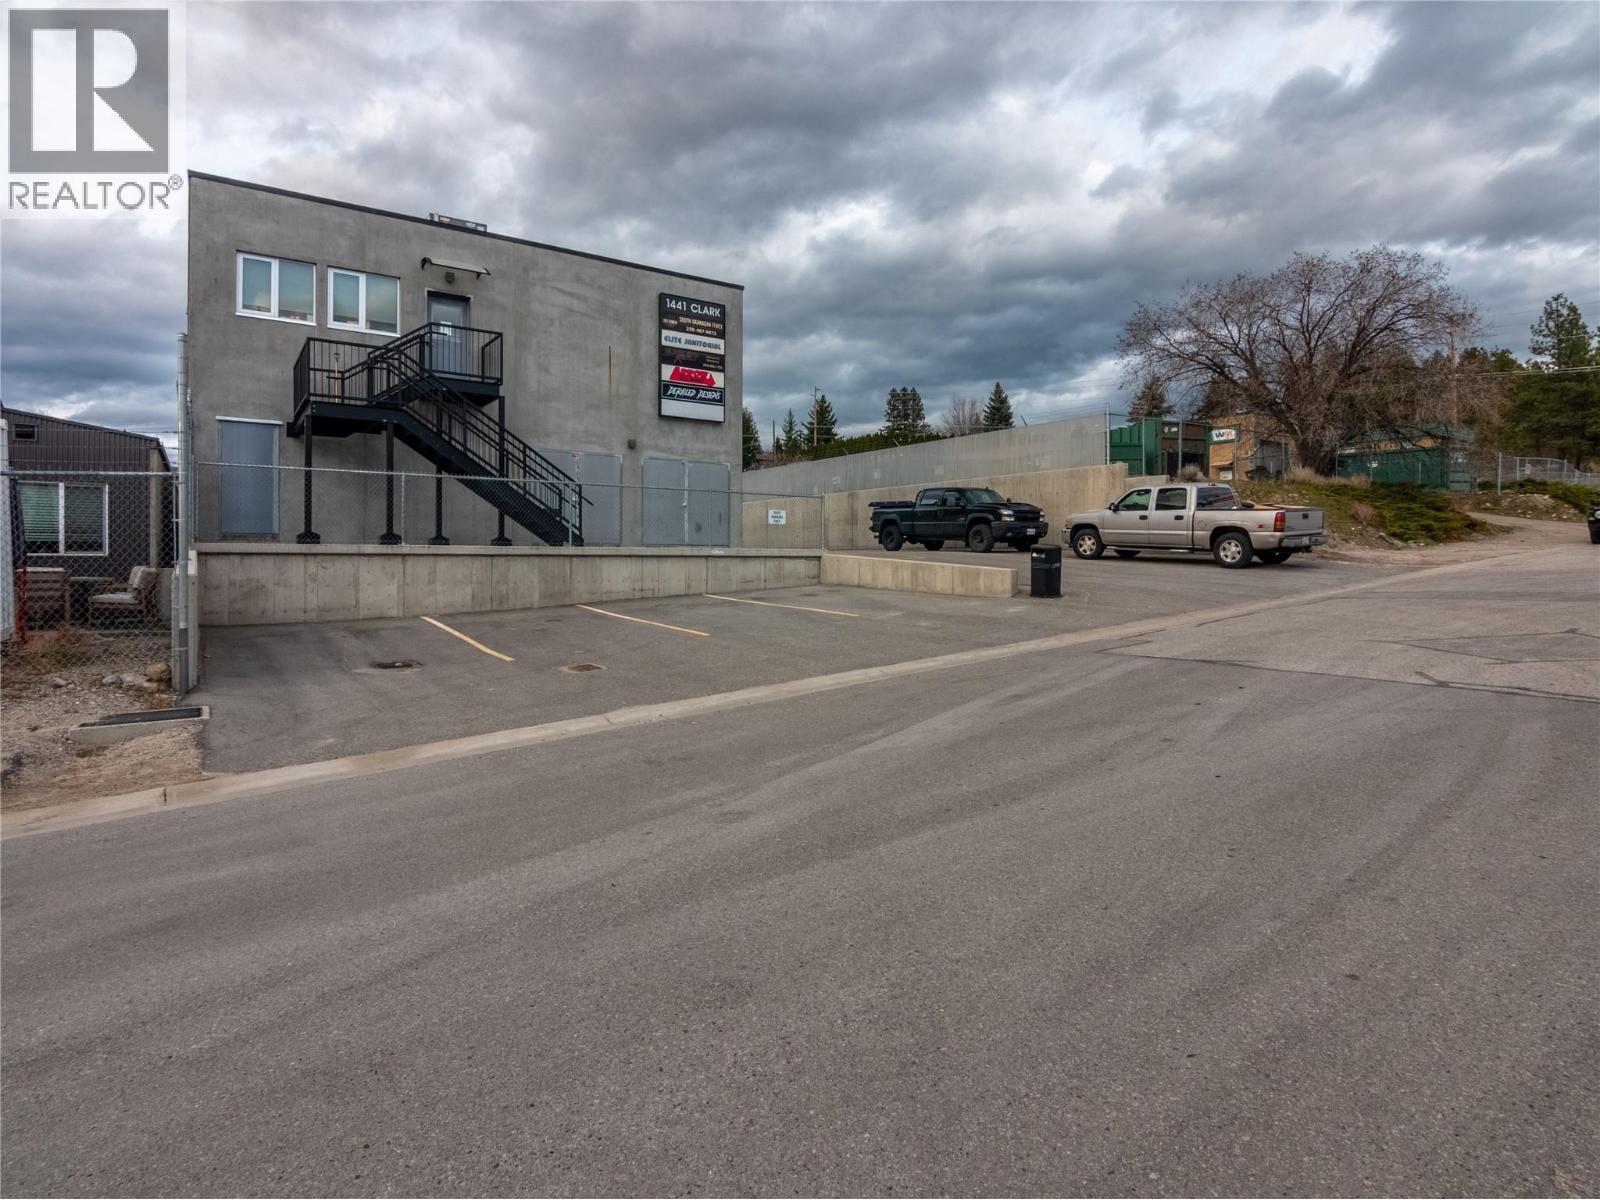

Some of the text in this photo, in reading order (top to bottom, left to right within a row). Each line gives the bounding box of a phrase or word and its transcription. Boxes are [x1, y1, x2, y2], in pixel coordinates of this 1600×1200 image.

[666, 298, 721, 317] 1441 CLARK
[664, 335, 721, 351] ELITE JANITORIAL
